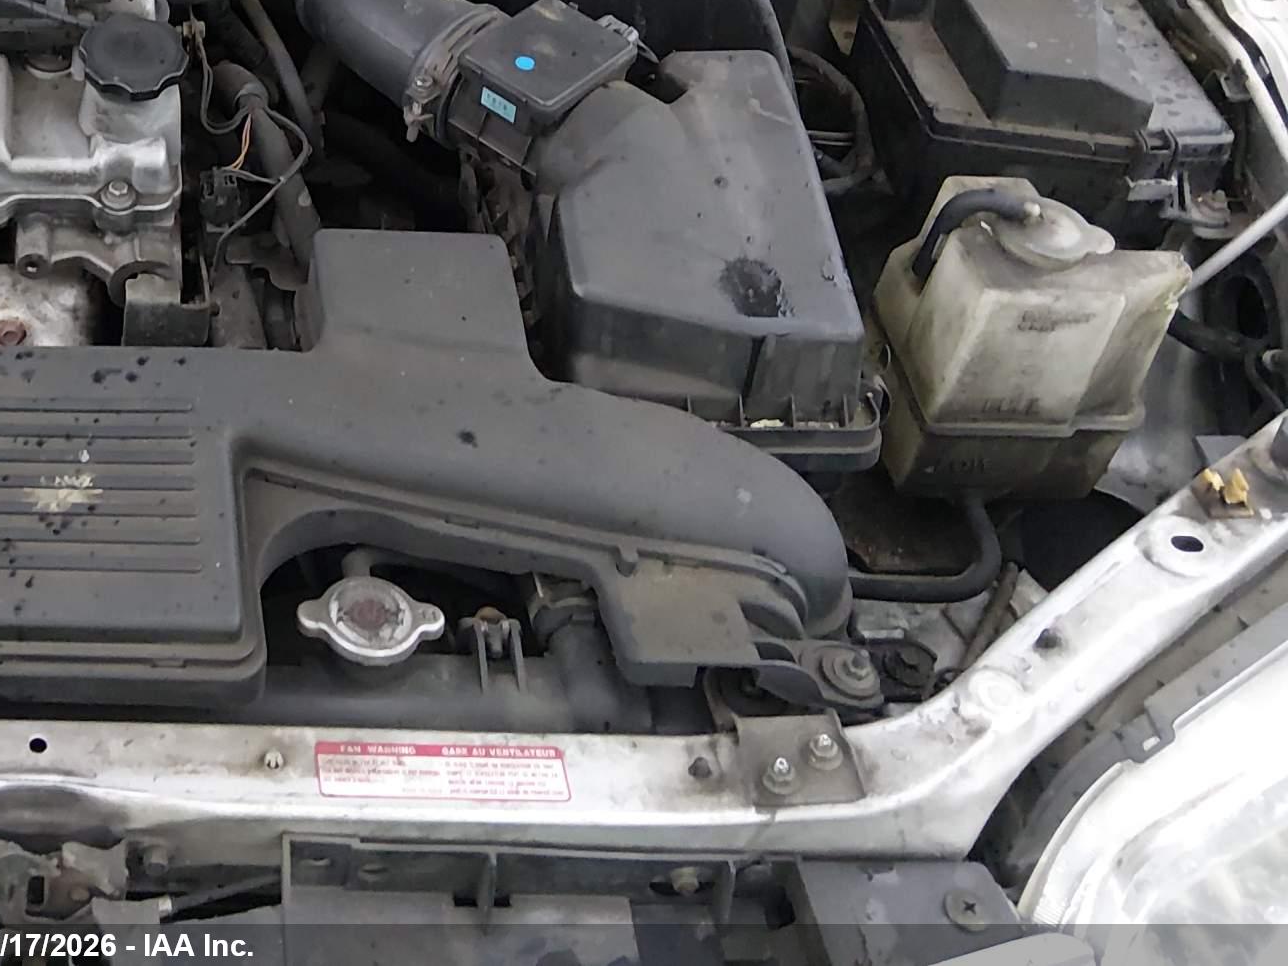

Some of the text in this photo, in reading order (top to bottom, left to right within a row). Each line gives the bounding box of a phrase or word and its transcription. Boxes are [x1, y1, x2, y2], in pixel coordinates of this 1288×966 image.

[339, 745, 416, 755] FAN WARNING
[472, 747, 486, 756] AU
[489, 747, 556, 758] VENTILATEUR
